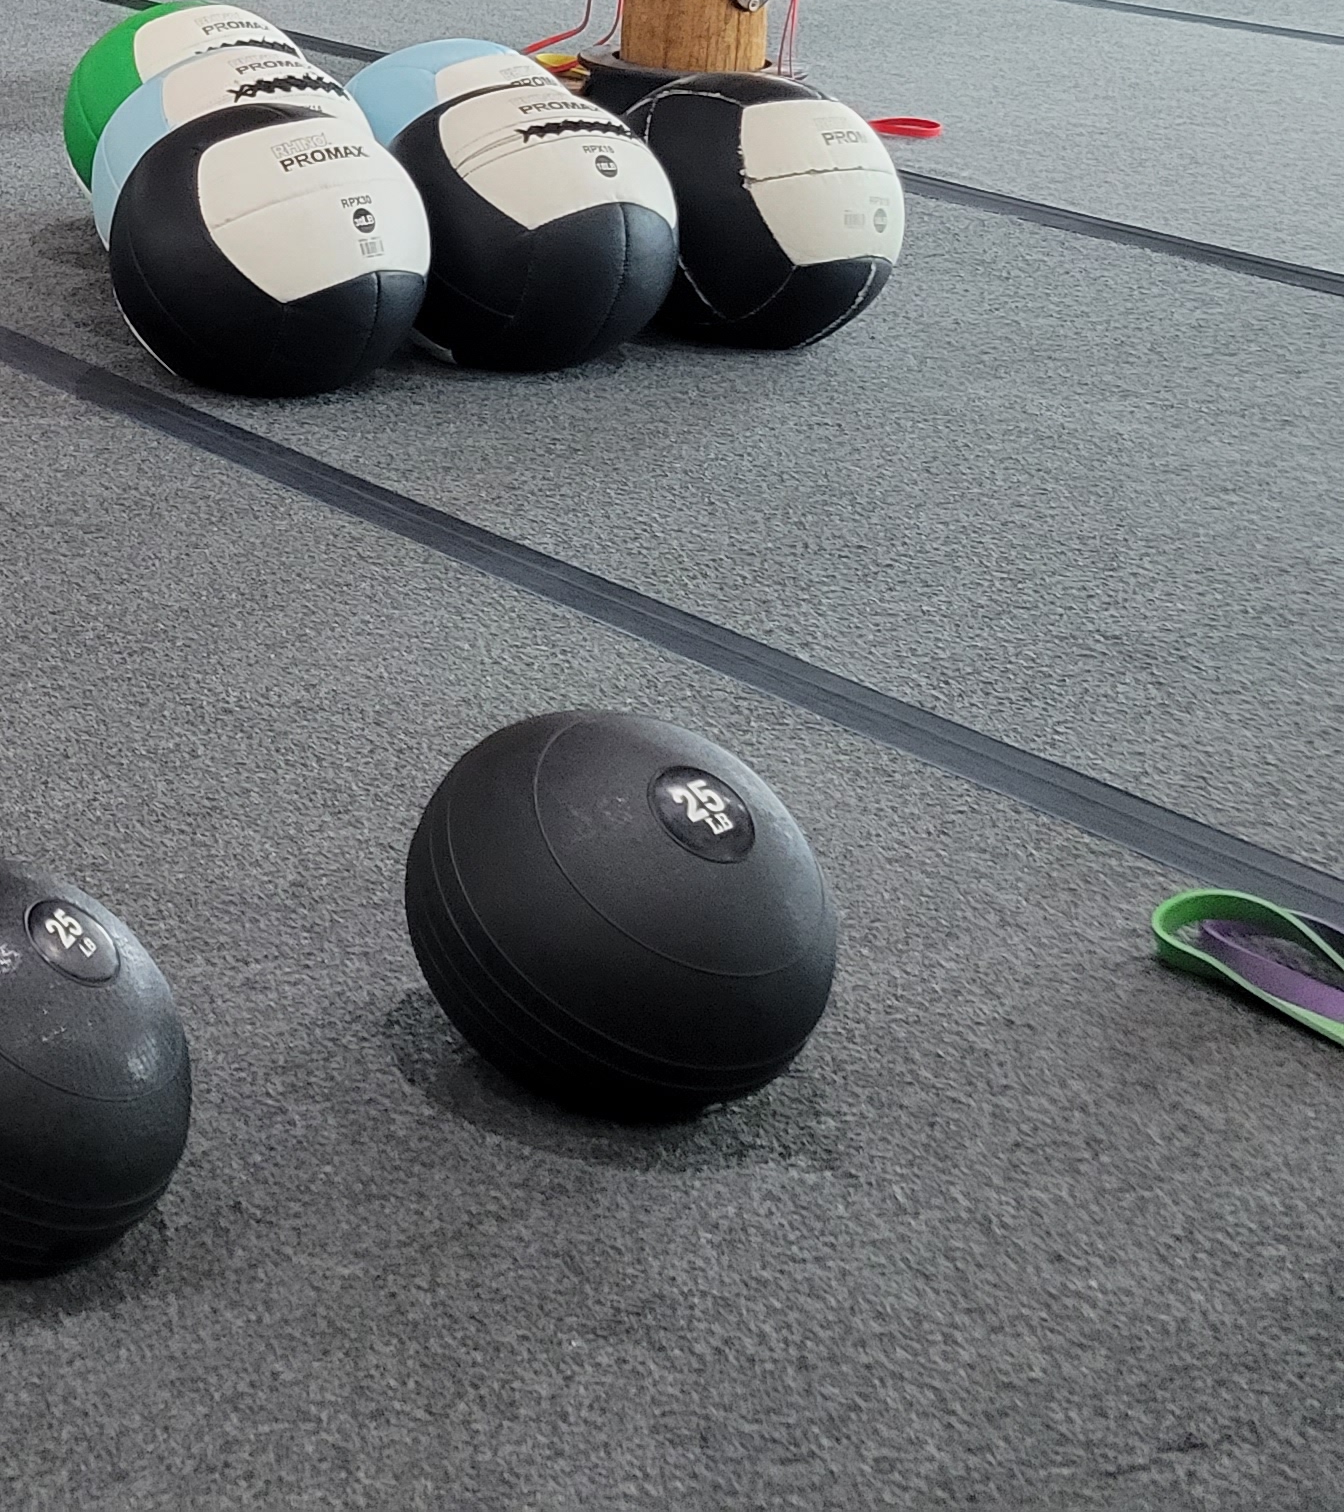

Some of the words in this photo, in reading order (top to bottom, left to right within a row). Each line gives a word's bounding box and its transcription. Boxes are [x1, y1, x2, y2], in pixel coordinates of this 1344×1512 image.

[270, 133, 328, 160] RHINO
[279, 145, 370, 173] PROMAX
[340, 194, 373, 209] RPX30
[667, 778, 725, 823] 25
[703, 812, 734, 835] LB
[44, 907, 84, 950] 25
[78, 936, 97, 958] LB
